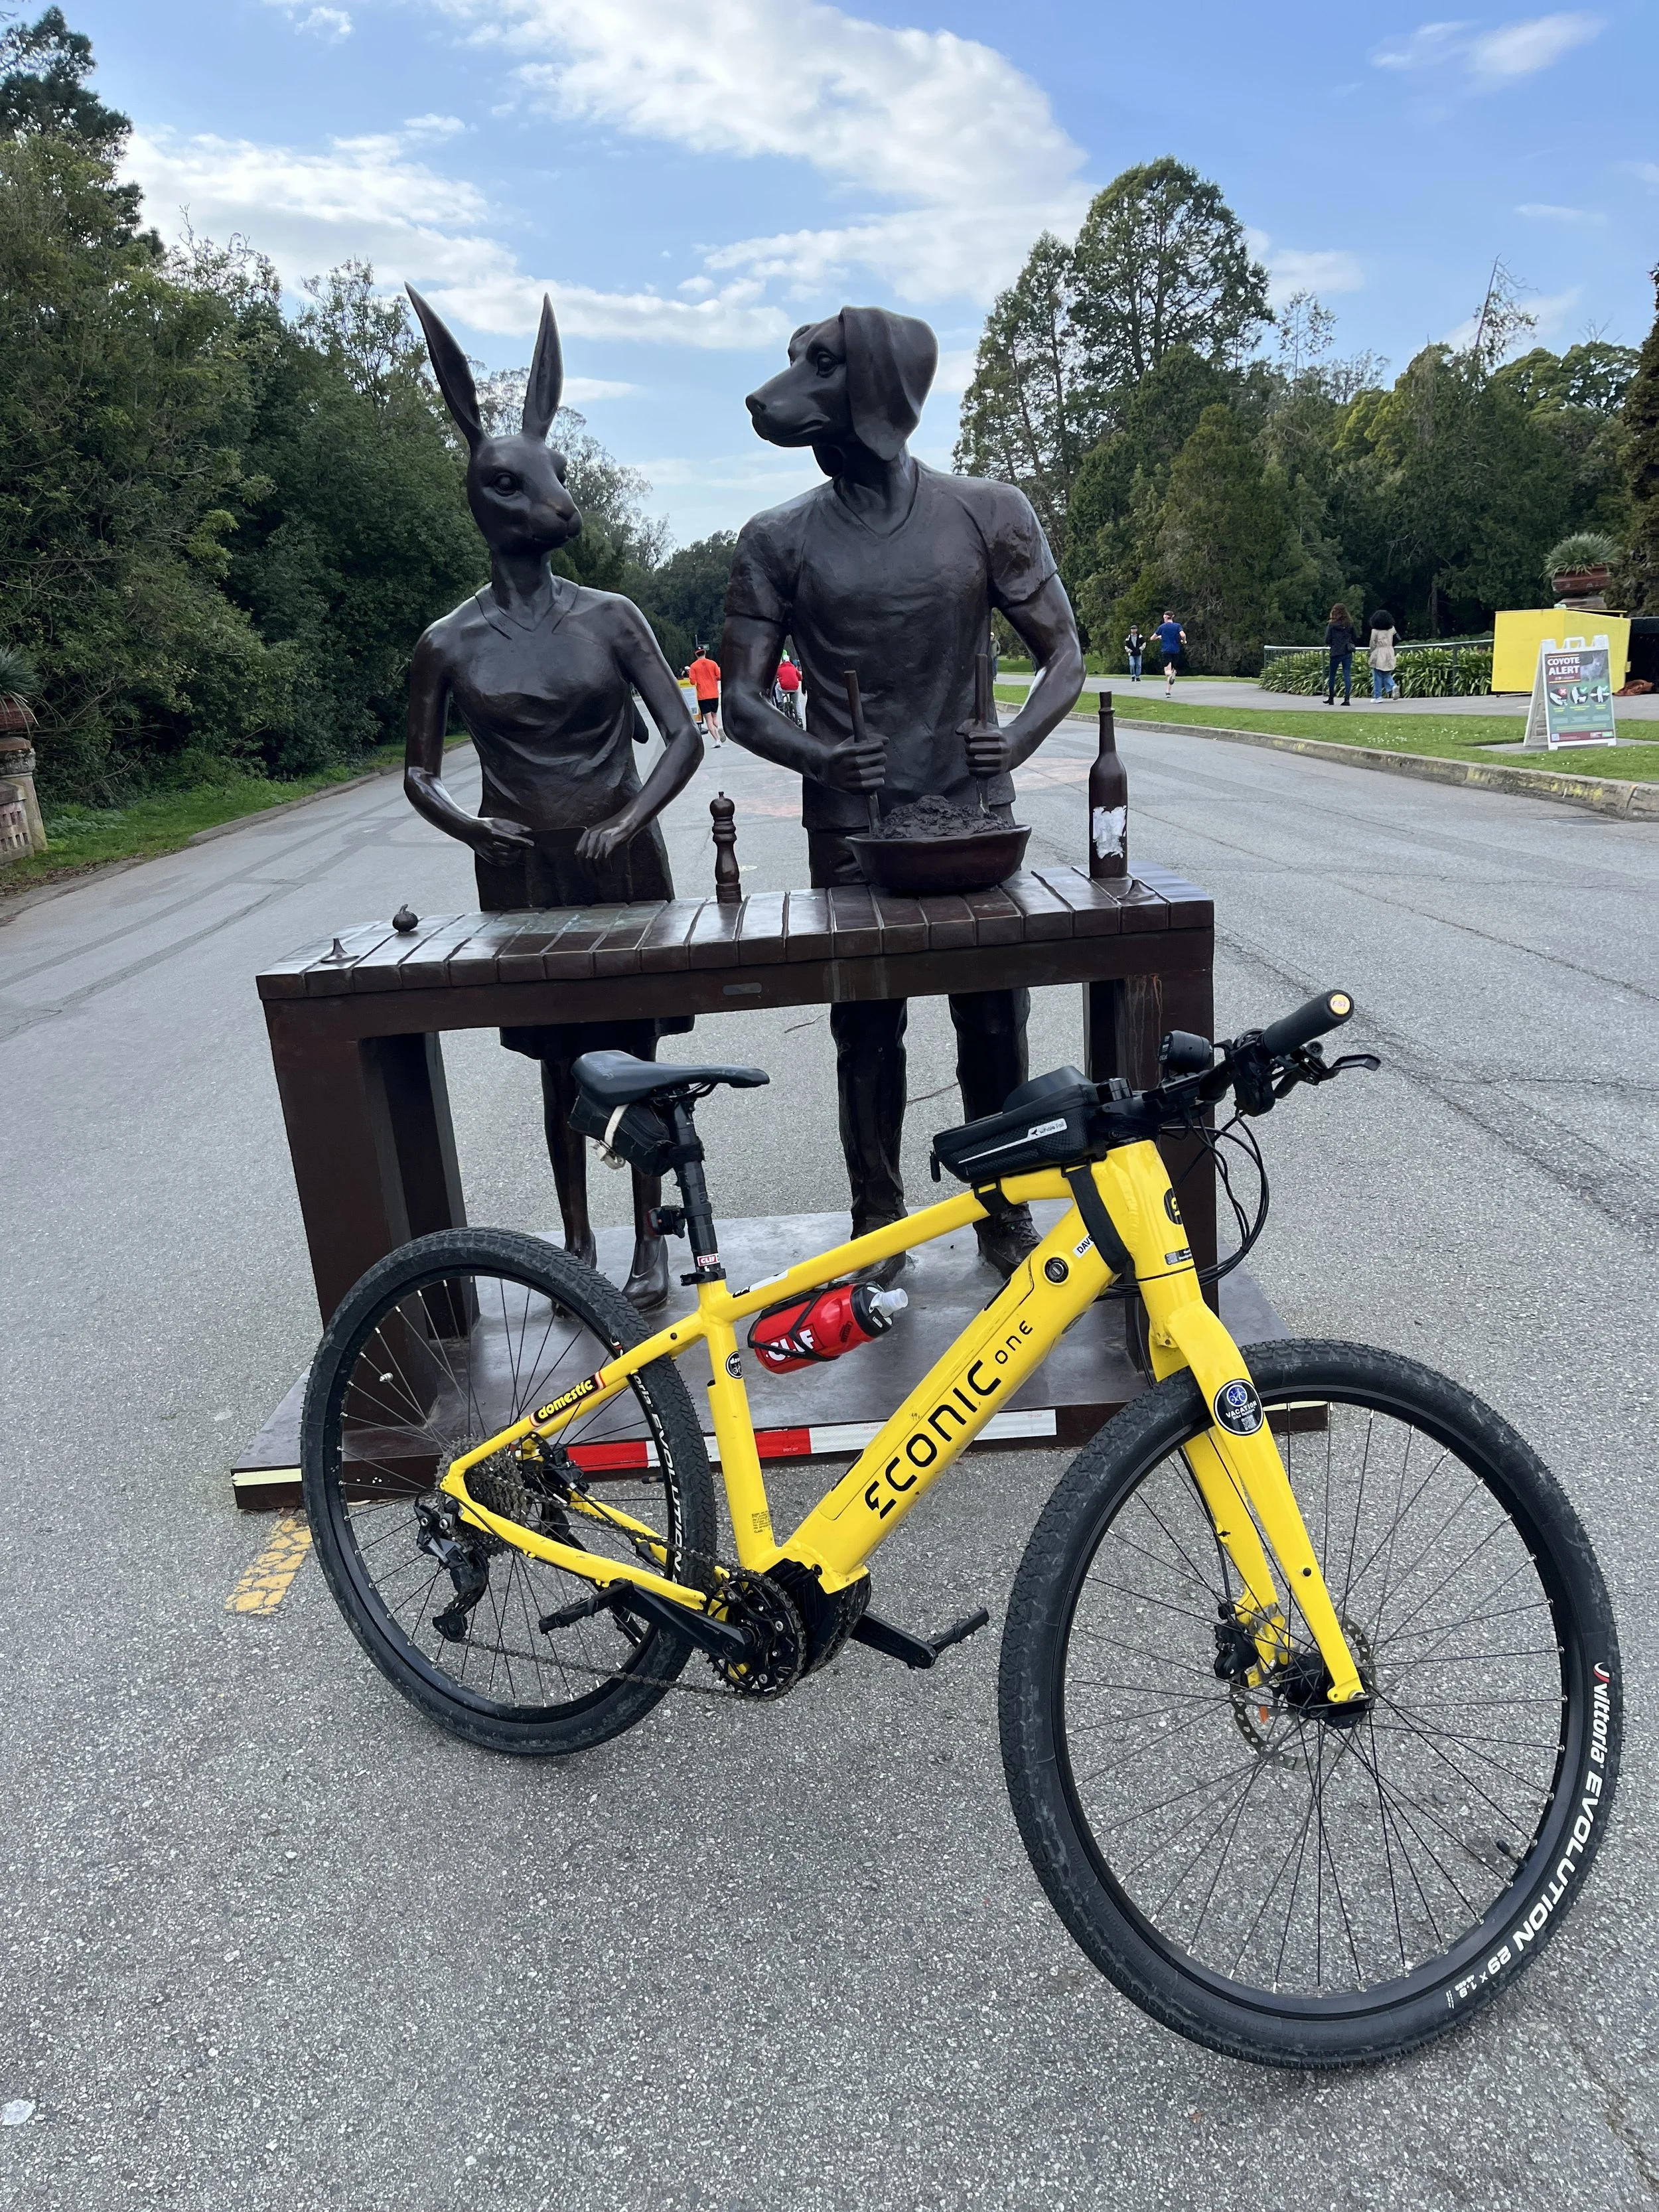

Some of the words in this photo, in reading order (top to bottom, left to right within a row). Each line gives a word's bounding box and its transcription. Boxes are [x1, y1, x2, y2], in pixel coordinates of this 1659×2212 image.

[1547, 656, 1580, 666] COYOTE
[1548, 666, 1580, 676] ALERT
[538, 1379, 594, 1419] domestic
[1226, 1400, 1258, 1418] VACATION
[1590, 1682, 1611, 1765] vittoria
[1512, 1770, 1603, 1952] EVOLUTION
[1487, 1945, 1512, 1975] 29
[1459, 1981, 1477, 1998] 1.9
